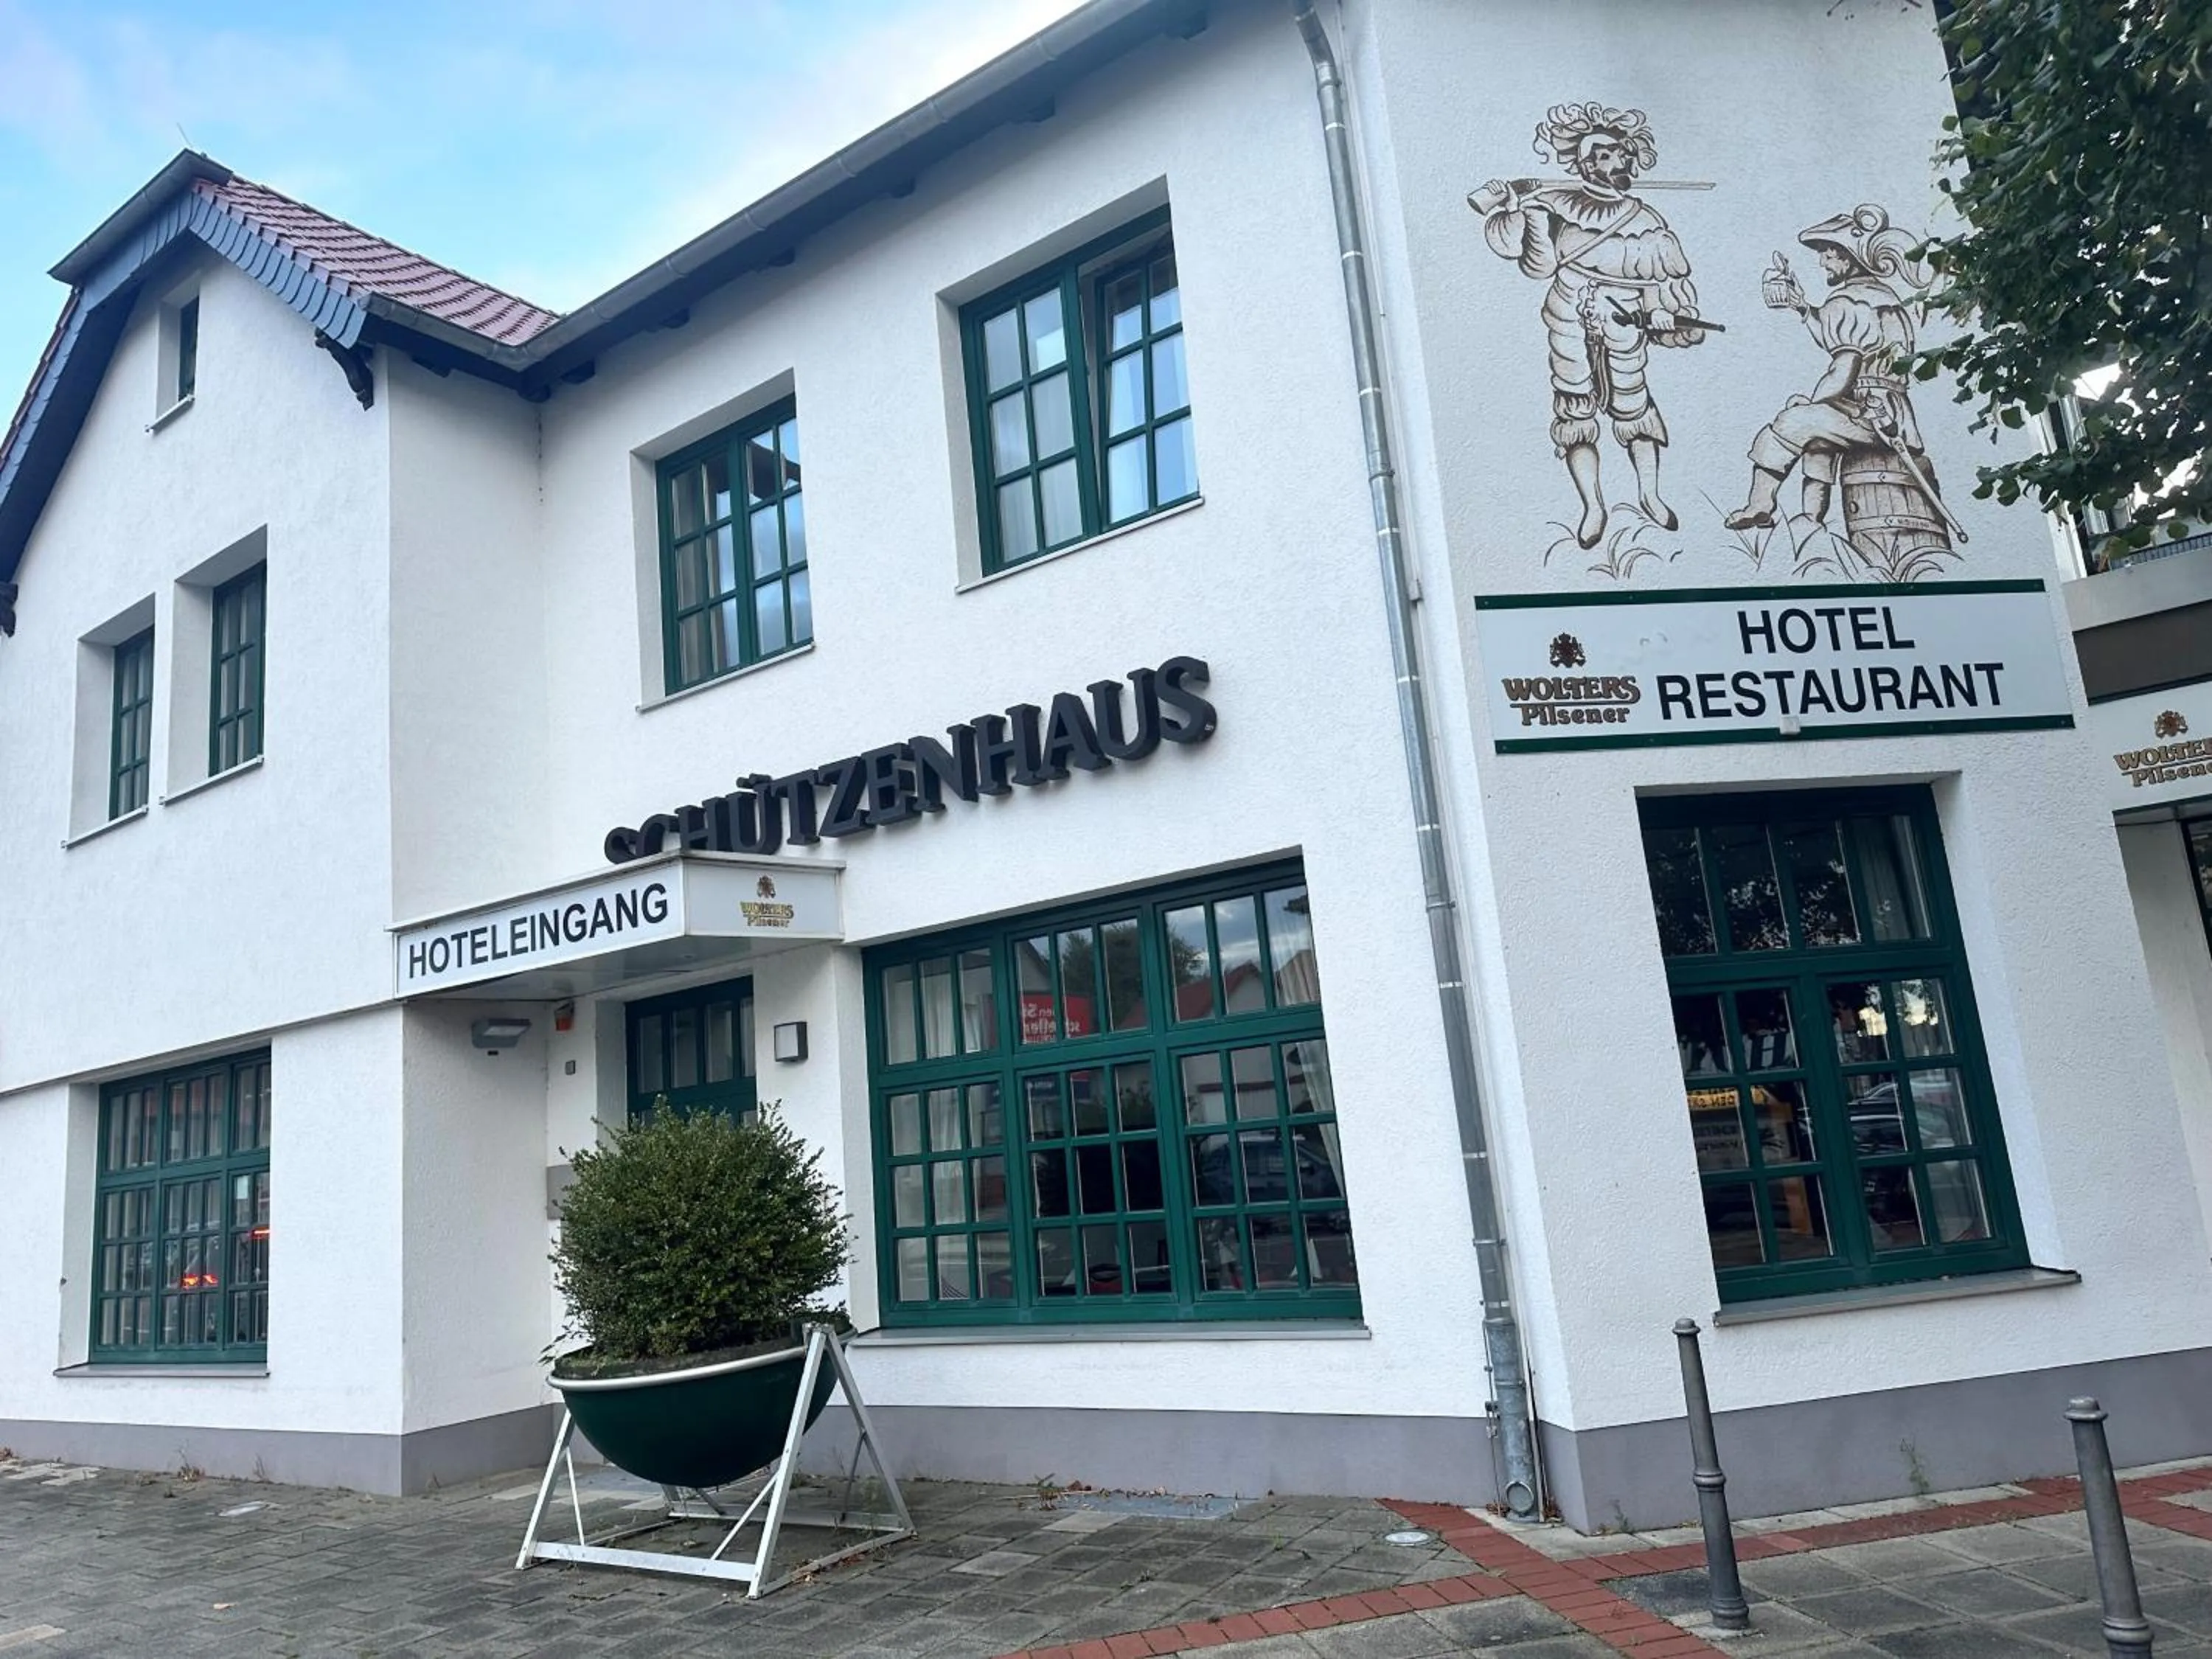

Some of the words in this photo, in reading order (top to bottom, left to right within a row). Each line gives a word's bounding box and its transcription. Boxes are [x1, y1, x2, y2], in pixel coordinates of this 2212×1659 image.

[1737, 606, 1915, 654] HOTEL
[1501, 675, 1641, 703] WOLTERS
[1656, 662, 2004, 720] RESTAURANT
[1520, 703, 1631, 726] Pilsener
[408, 883, 668, 978] HOTELEINGANG
